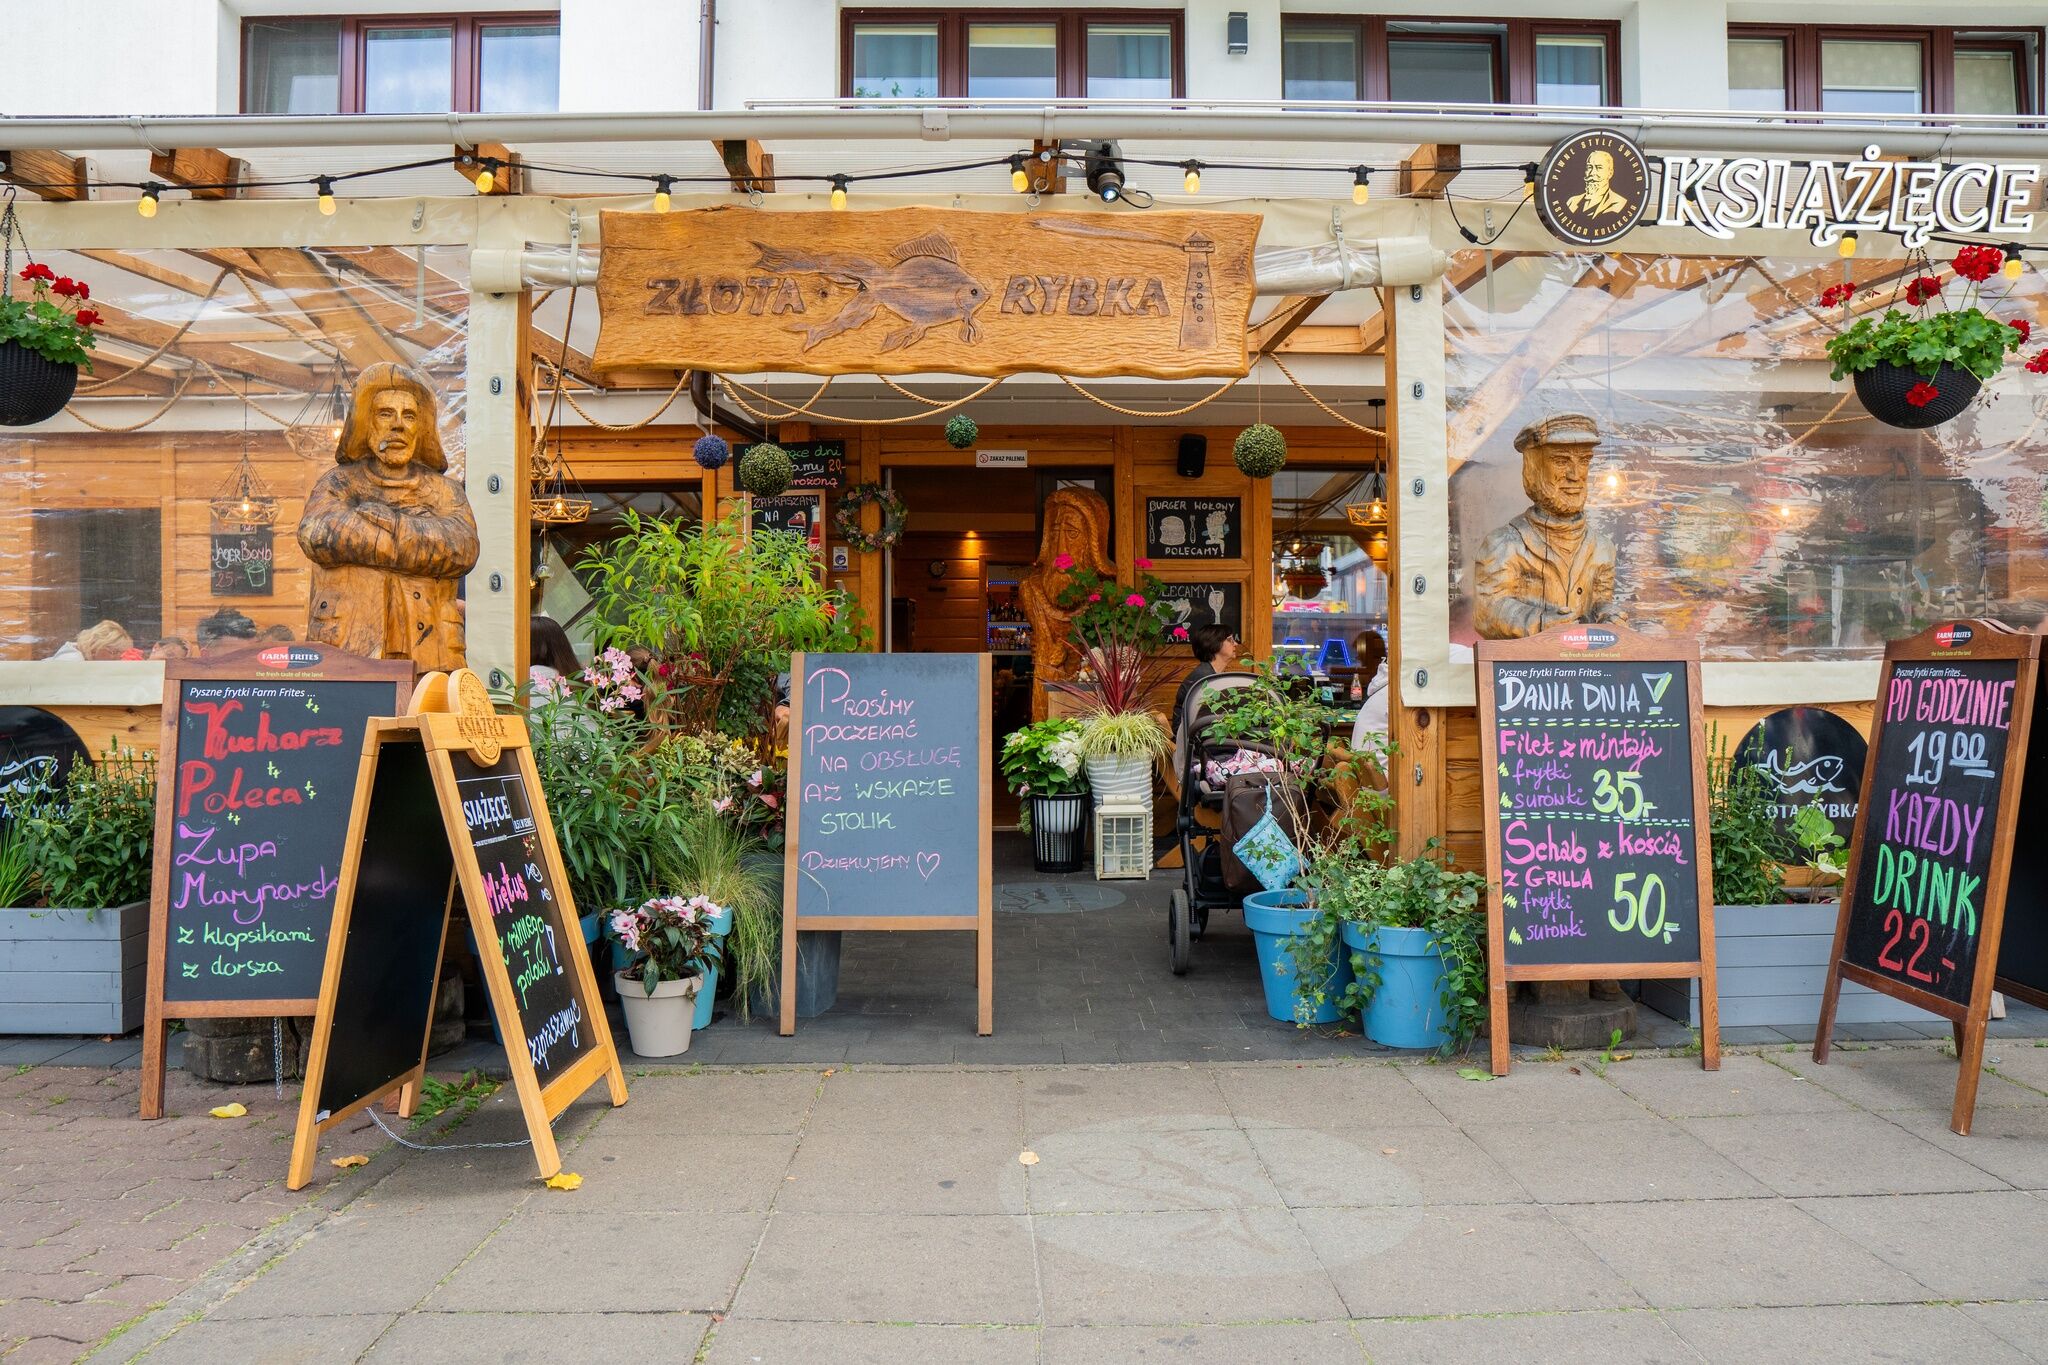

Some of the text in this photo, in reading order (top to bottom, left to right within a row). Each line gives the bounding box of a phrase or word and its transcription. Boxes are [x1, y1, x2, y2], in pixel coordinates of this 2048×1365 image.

[1552, 148, 1575, 180] PIWNE
[1581, 138, 1612, 149] STYLE
[1658, 144, 2040, 248] KSIĄŻĘCE
[1594, 205, 1637, 236] KOLEKCJA
[644, 274, 1171, 317] ZŁOTA RYBKA
[815, 445, 841, 457] dni
[765, 510, 779, 522] NA
[1149, 500, 1187, 512] BURGER
[1498, 668, 1528, 679] Pyszne
[1529, 668, 1552, 678] frytki
[1553, 668, 1577, 677] Farm
[1578, 668, 1602, 677] Frites
[189, 687, 222, 698] Pyszne
[222, 687, 250, 698] frytki
[251, 687, 277, 697] Farm
[278, 687, 305, 697] Frites
[807, 667, 915, 718] PROSIMY
[1498, 677, 1574, 712] DANIA
[1886, 678, 2016, 730] PO GODZINIE
[184, 700, 342, 760] Kucharz
[806, 718, 918, 756] POCZEKAĆ
[820, 746, 961, 774] NA OBSŁUGĘ
[1500, 729, 1663, 773] Filet z mintaja
[178, 760, 304, 818] Poleca
[804, 776, 955, 803] AŻ WSKAŻE
[1512, 758, 1572, 790] frytki
[462, 792, 512, 832] SIĄŻĘCE
[1514, 783, 1588, 809] surówki
[819, 811, 896, 835] STOLIK
[1505, 820, 1689, 865] Schab z kością
[482, 862, 529, 916] Miętus
[1525, 865, 1593, 890] GRILLA
[1873, 844, 1981, 936] DRINK
[1521, 888, 1573, 923] frytki
[177, 921, 316, 953] z klopsikami
[182, 954, 284, 979] z dorsza
